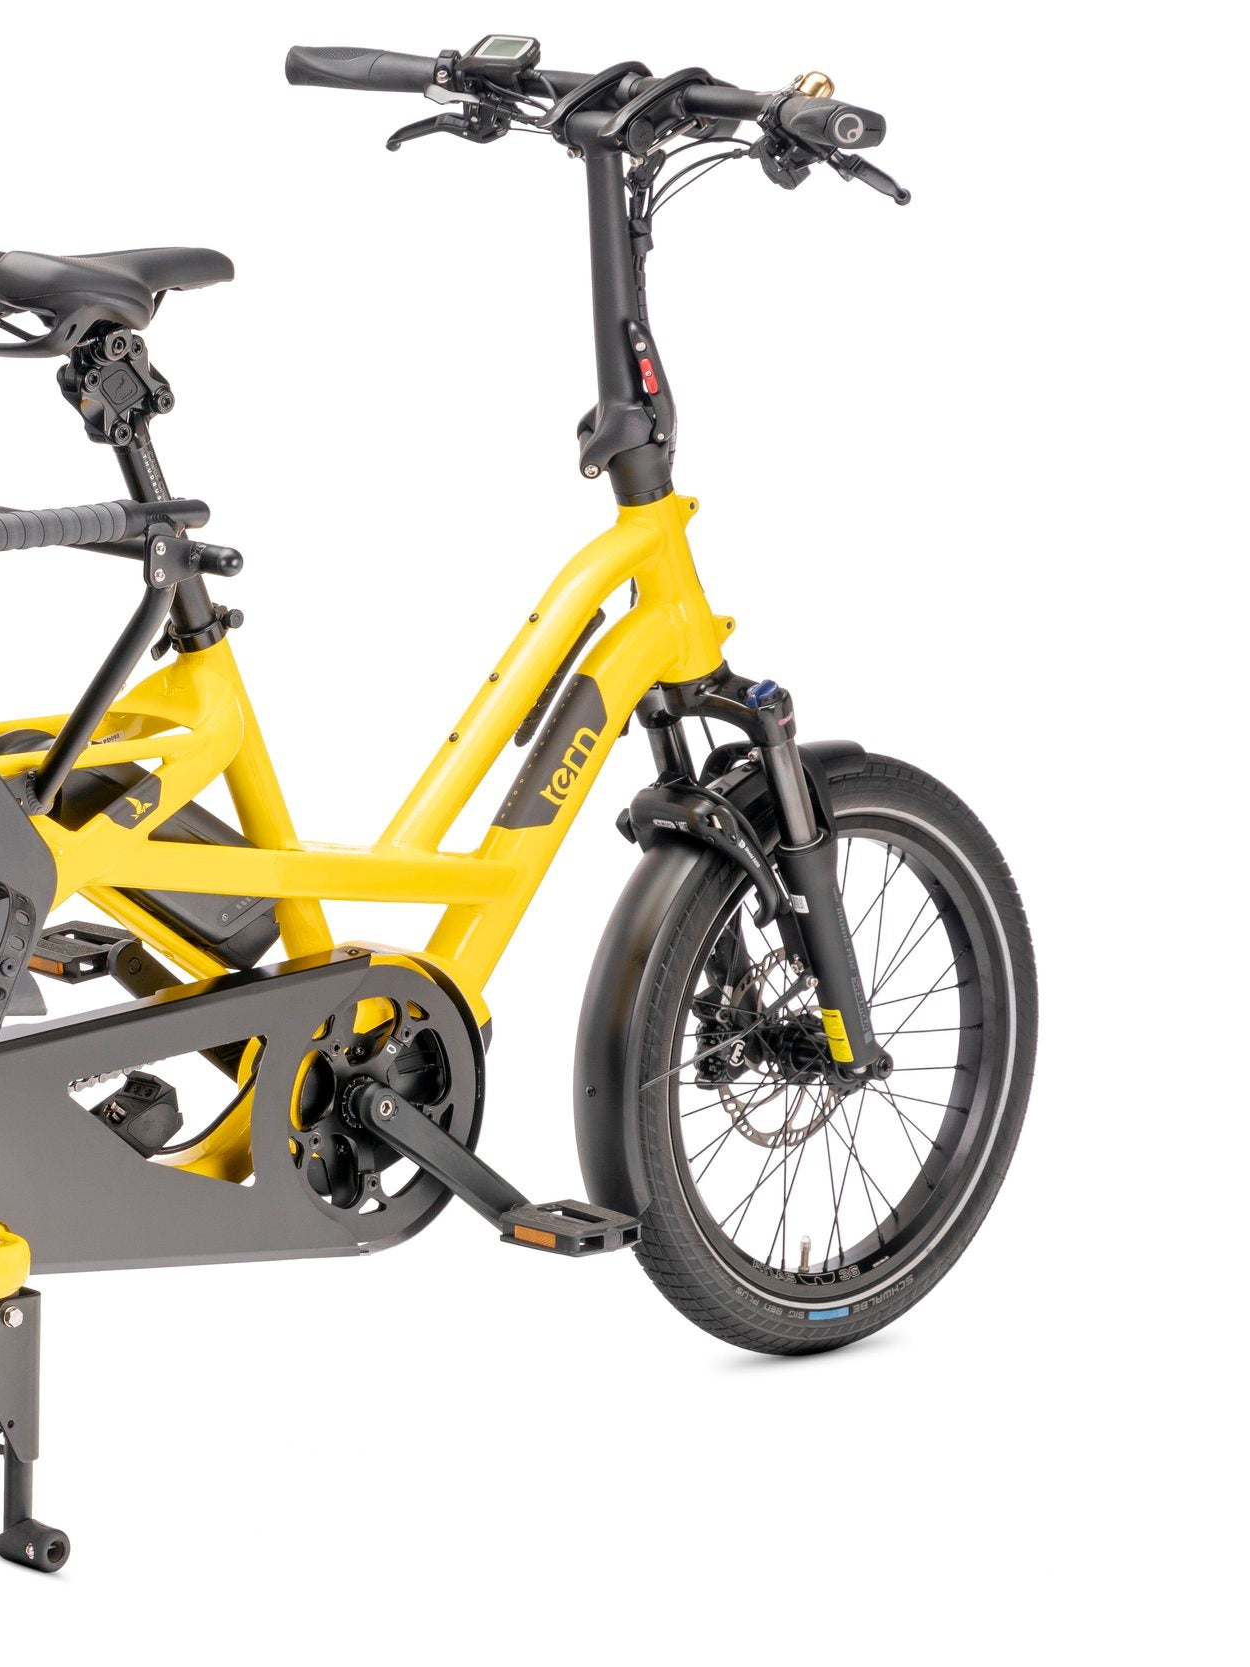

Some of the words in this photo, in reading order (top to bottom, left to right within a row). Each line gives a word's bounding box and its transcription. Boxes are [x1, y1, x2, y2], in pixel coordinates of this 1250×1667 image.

[539, 727, 600, 806] tern
[839, 1264, 861, 1281] 36
[735, 1286, 760, 1306] PLUS
[853, 1273, 914, 1313] SCHWALBE
